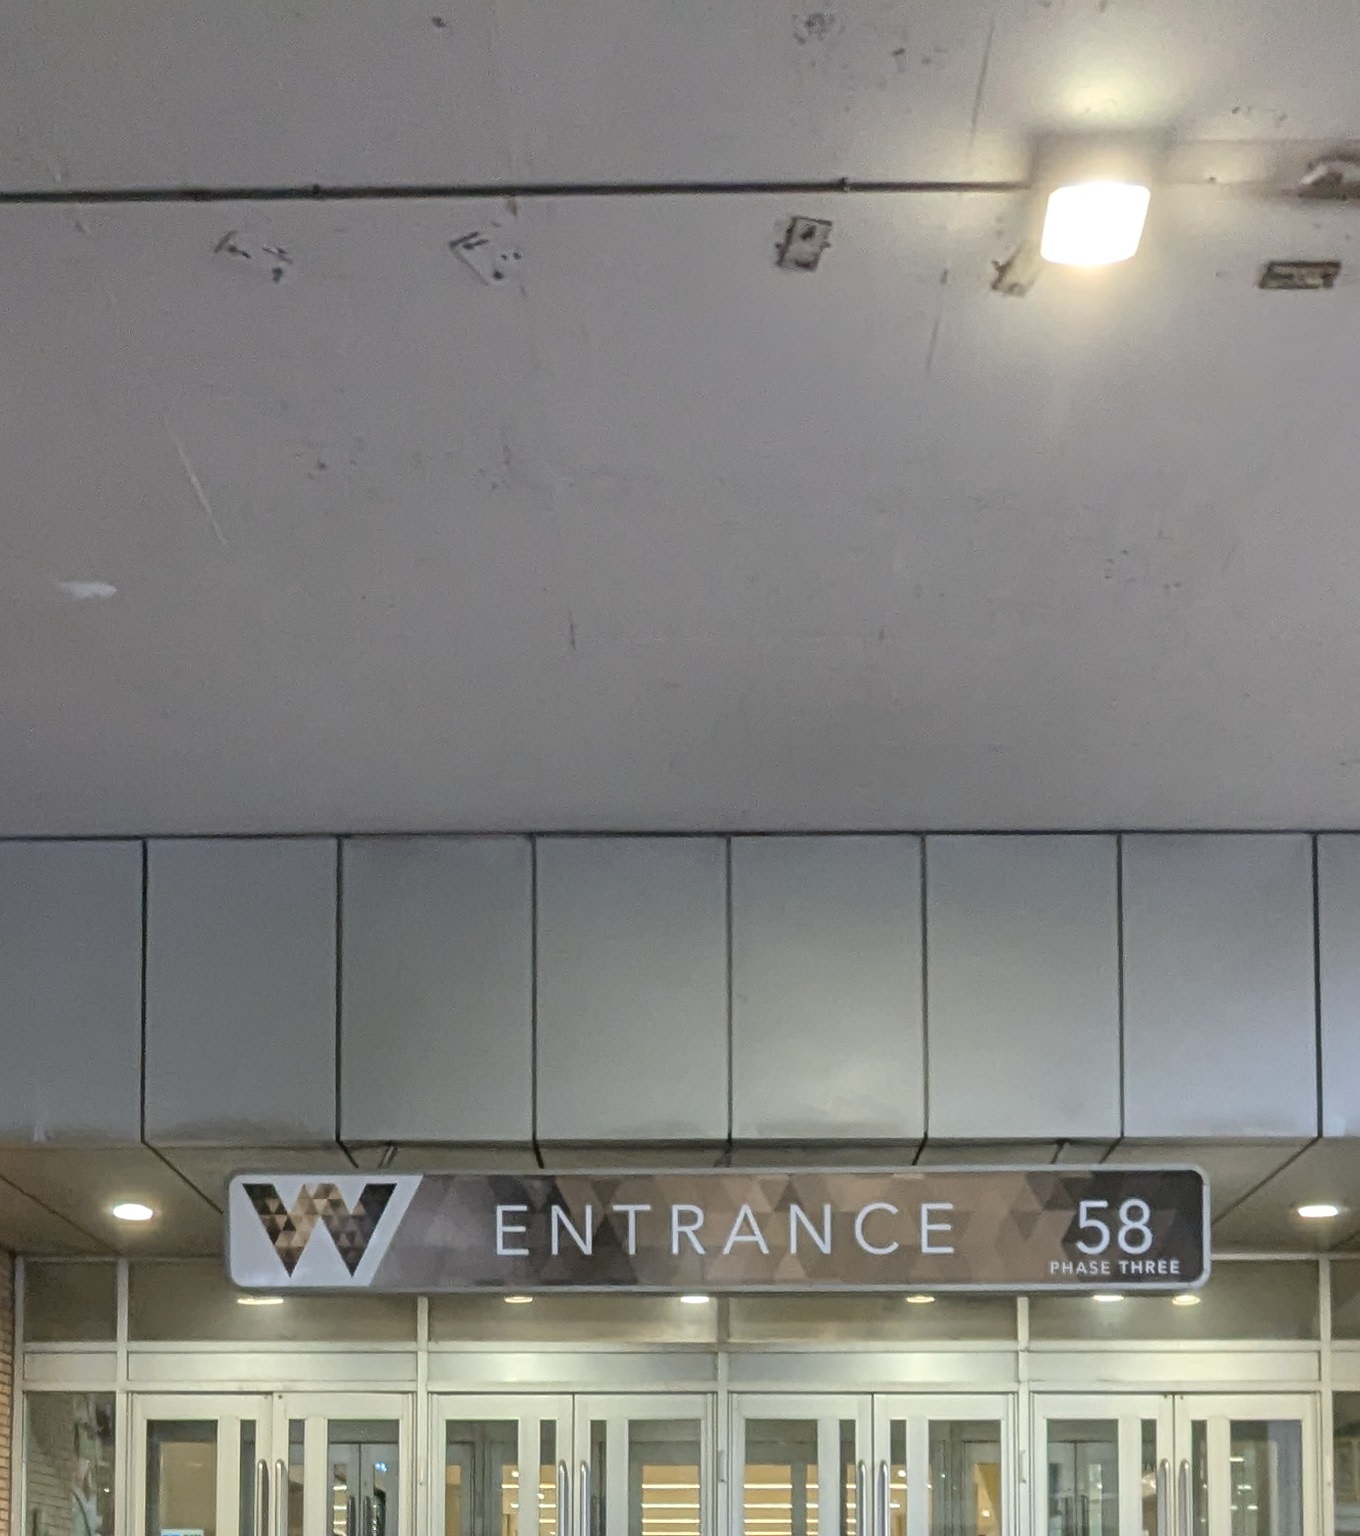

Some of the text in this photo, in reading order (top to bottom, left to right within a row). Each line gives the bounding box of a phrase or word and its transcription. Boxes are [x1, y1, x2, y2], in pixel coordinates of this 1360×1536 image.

[495, 1202, 956, 1257] ENTRANCE
[1075, 1198, 1154, 1255] 58
[1049, 1259, 1181, 1275] PHASE THREE
